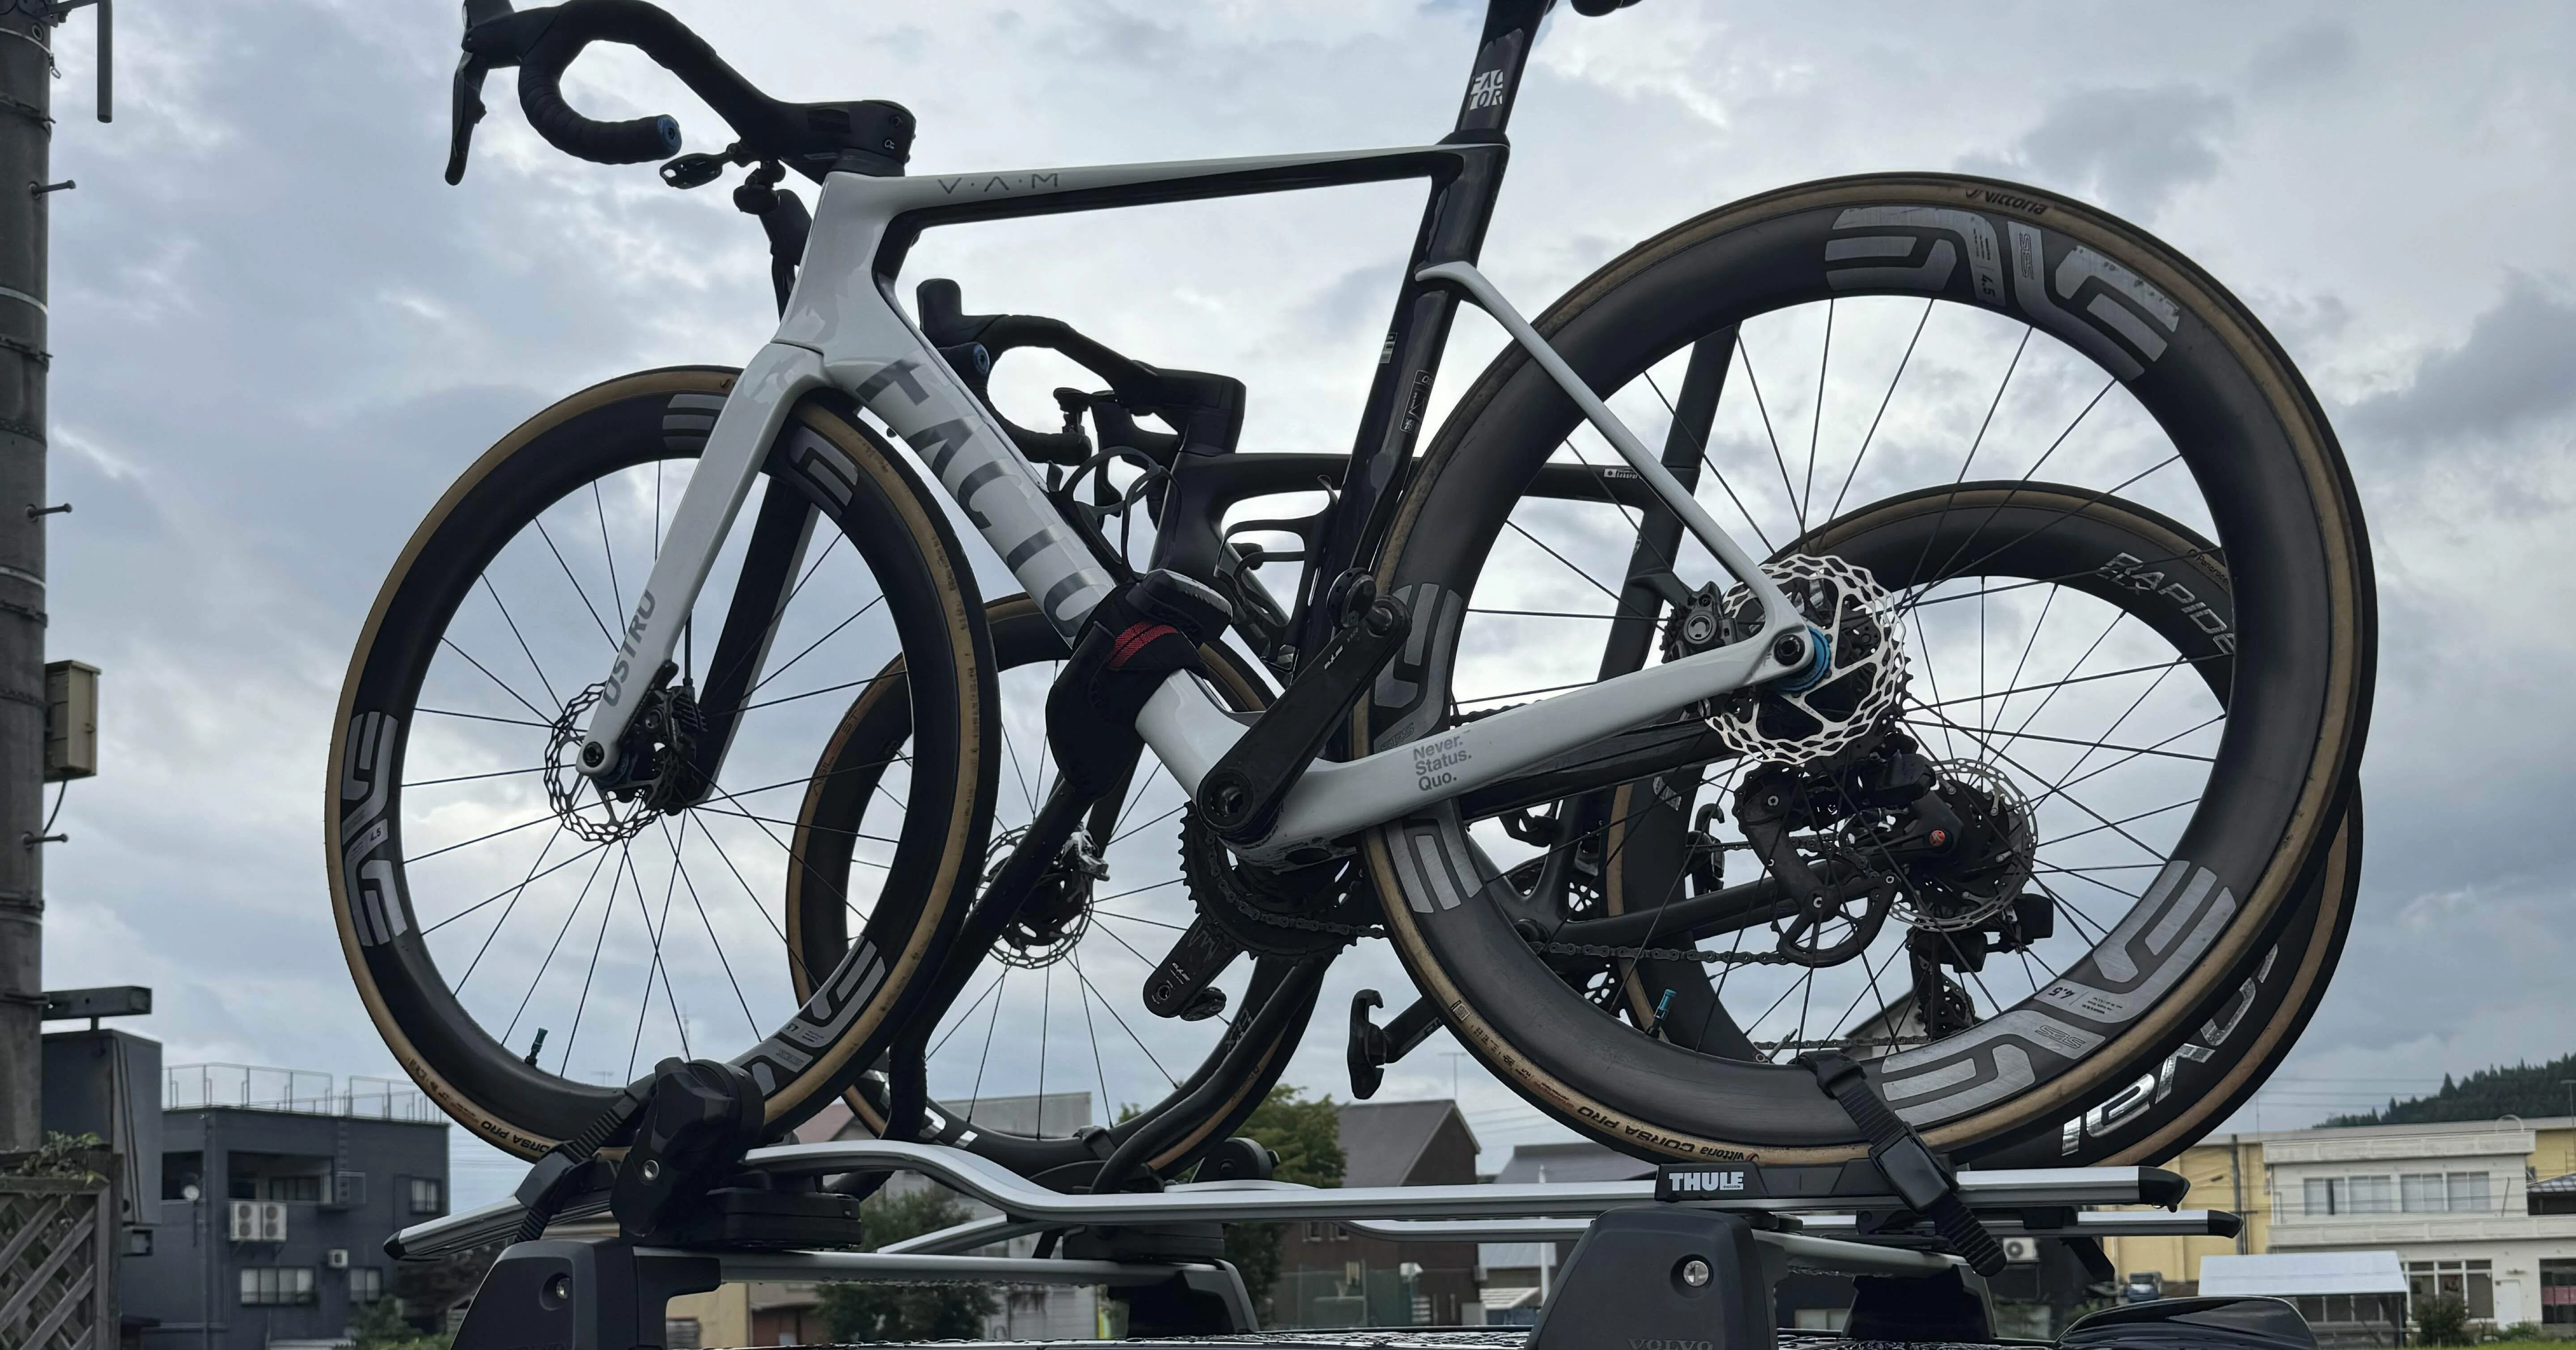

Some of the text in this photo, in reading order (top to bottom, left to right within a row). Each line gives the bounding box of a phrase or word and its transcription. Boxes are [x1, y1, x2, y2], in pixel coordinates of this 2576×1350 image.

[855, 349, 1111, 639] FACTO
[1413, 736, 1463, 761] Never.
[1415, 750, 1472, 776] Status.
[1418, 772, 1457, 791] Quo.
[1577, 1105, 1619, 1129] PRO
[481, 1120, 551, 1155] ORSA PRO
[1625, 1126, 1695, 1153] CORSA
[1669, 1171, 1744, 1191] THULE
